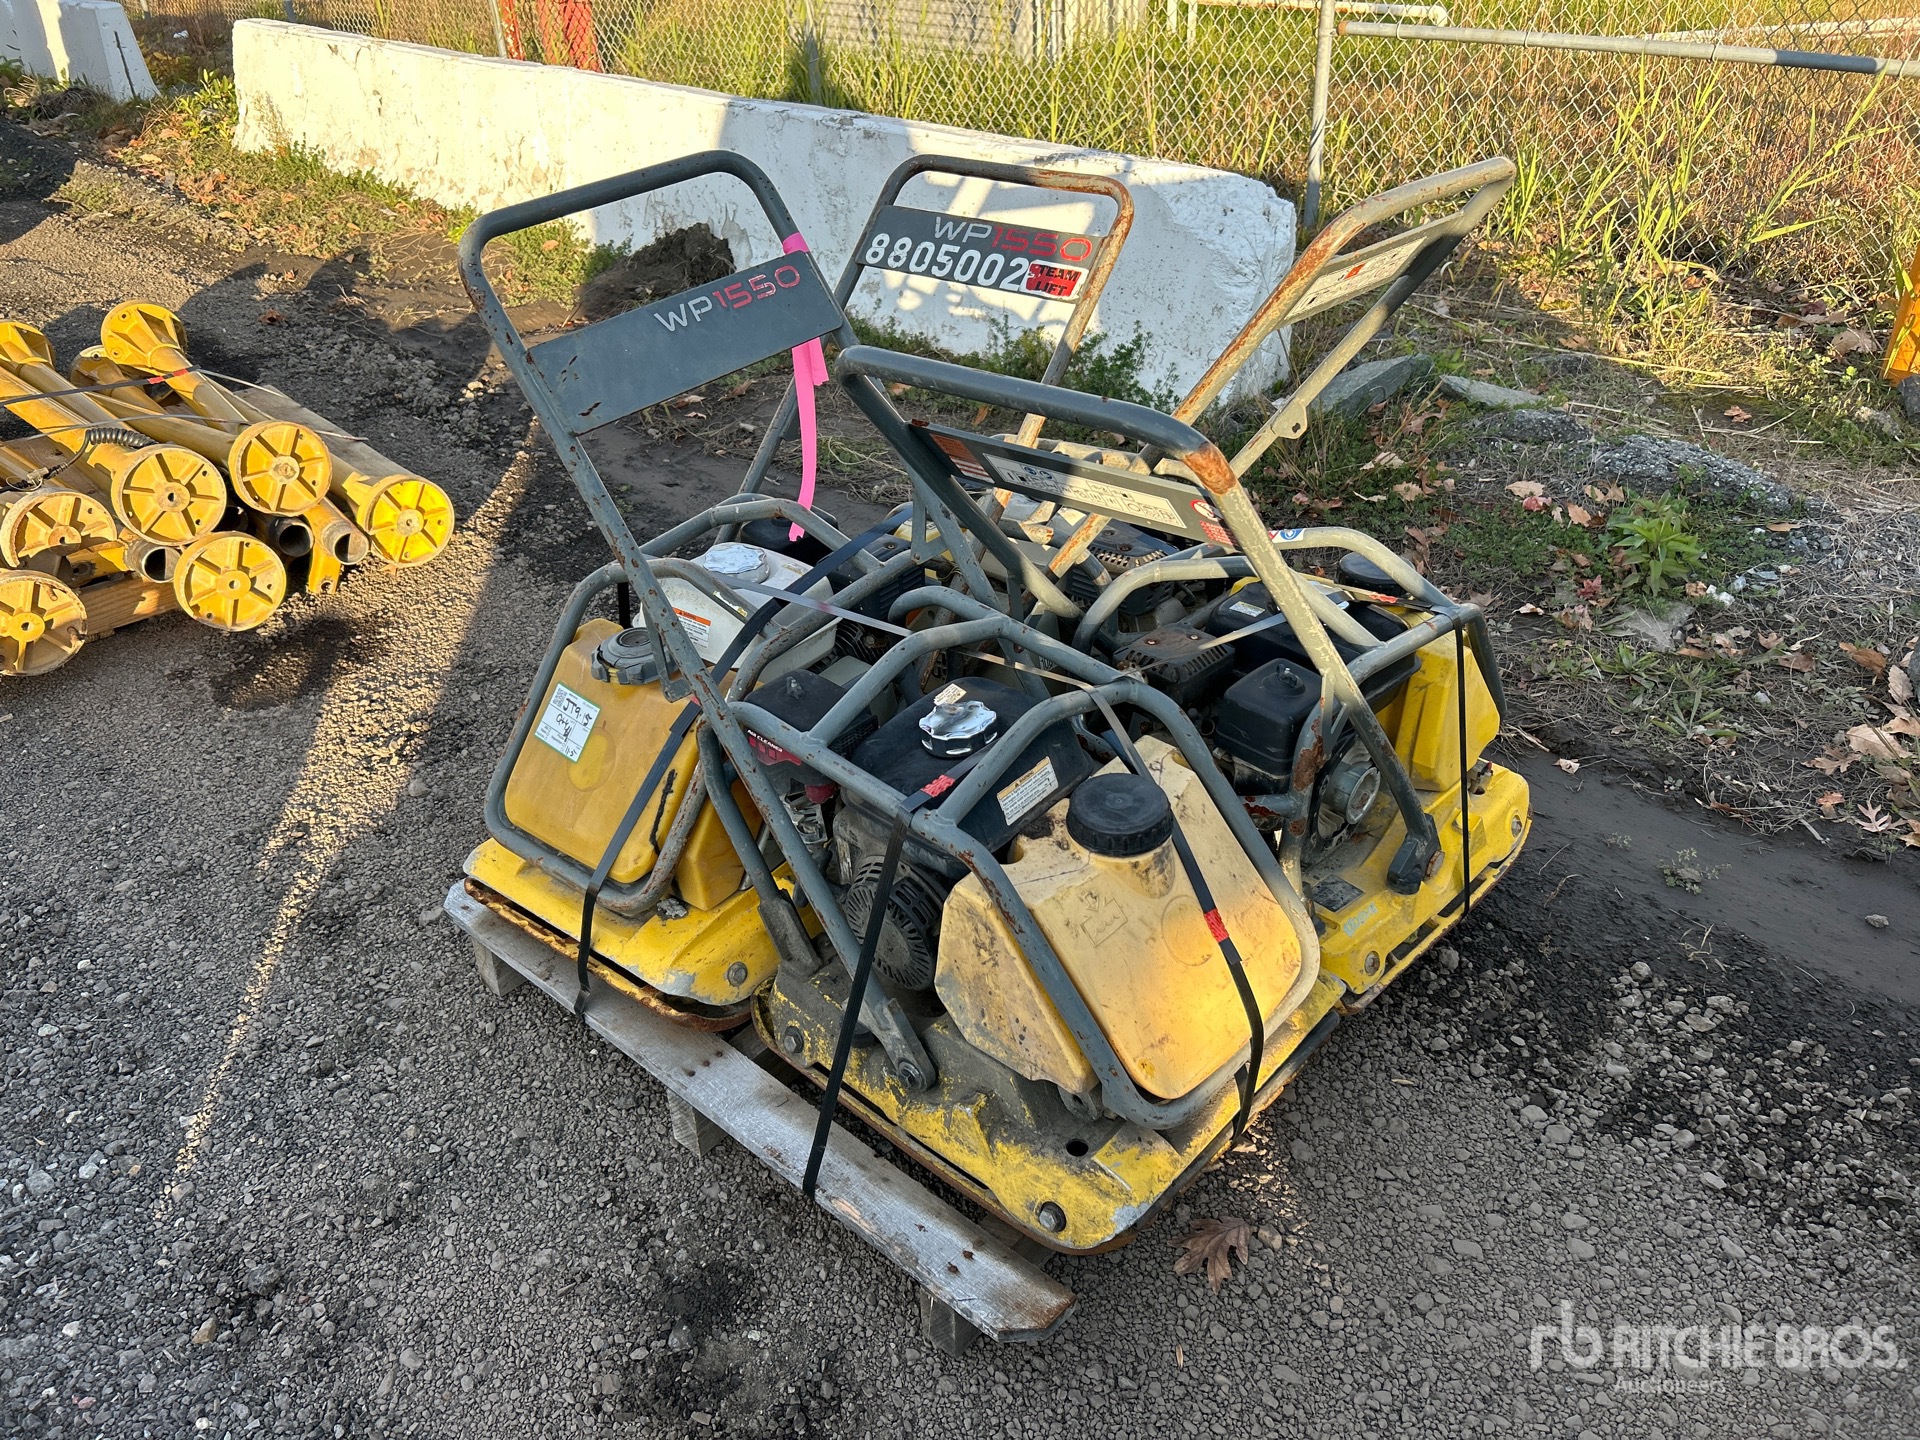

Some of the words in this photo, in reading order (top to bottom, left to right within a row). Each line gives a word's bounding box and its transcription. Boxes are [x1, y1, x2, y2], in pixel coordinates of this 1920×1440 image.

[865, 232, 1029, 292] 8805002
[934, 216, 1093, 263] WP1550
[1034, 279, 1068, 296] LIFT
[1038, 264, 1080, 282] TEAM
[653, 264, 802, 332] WP1550
